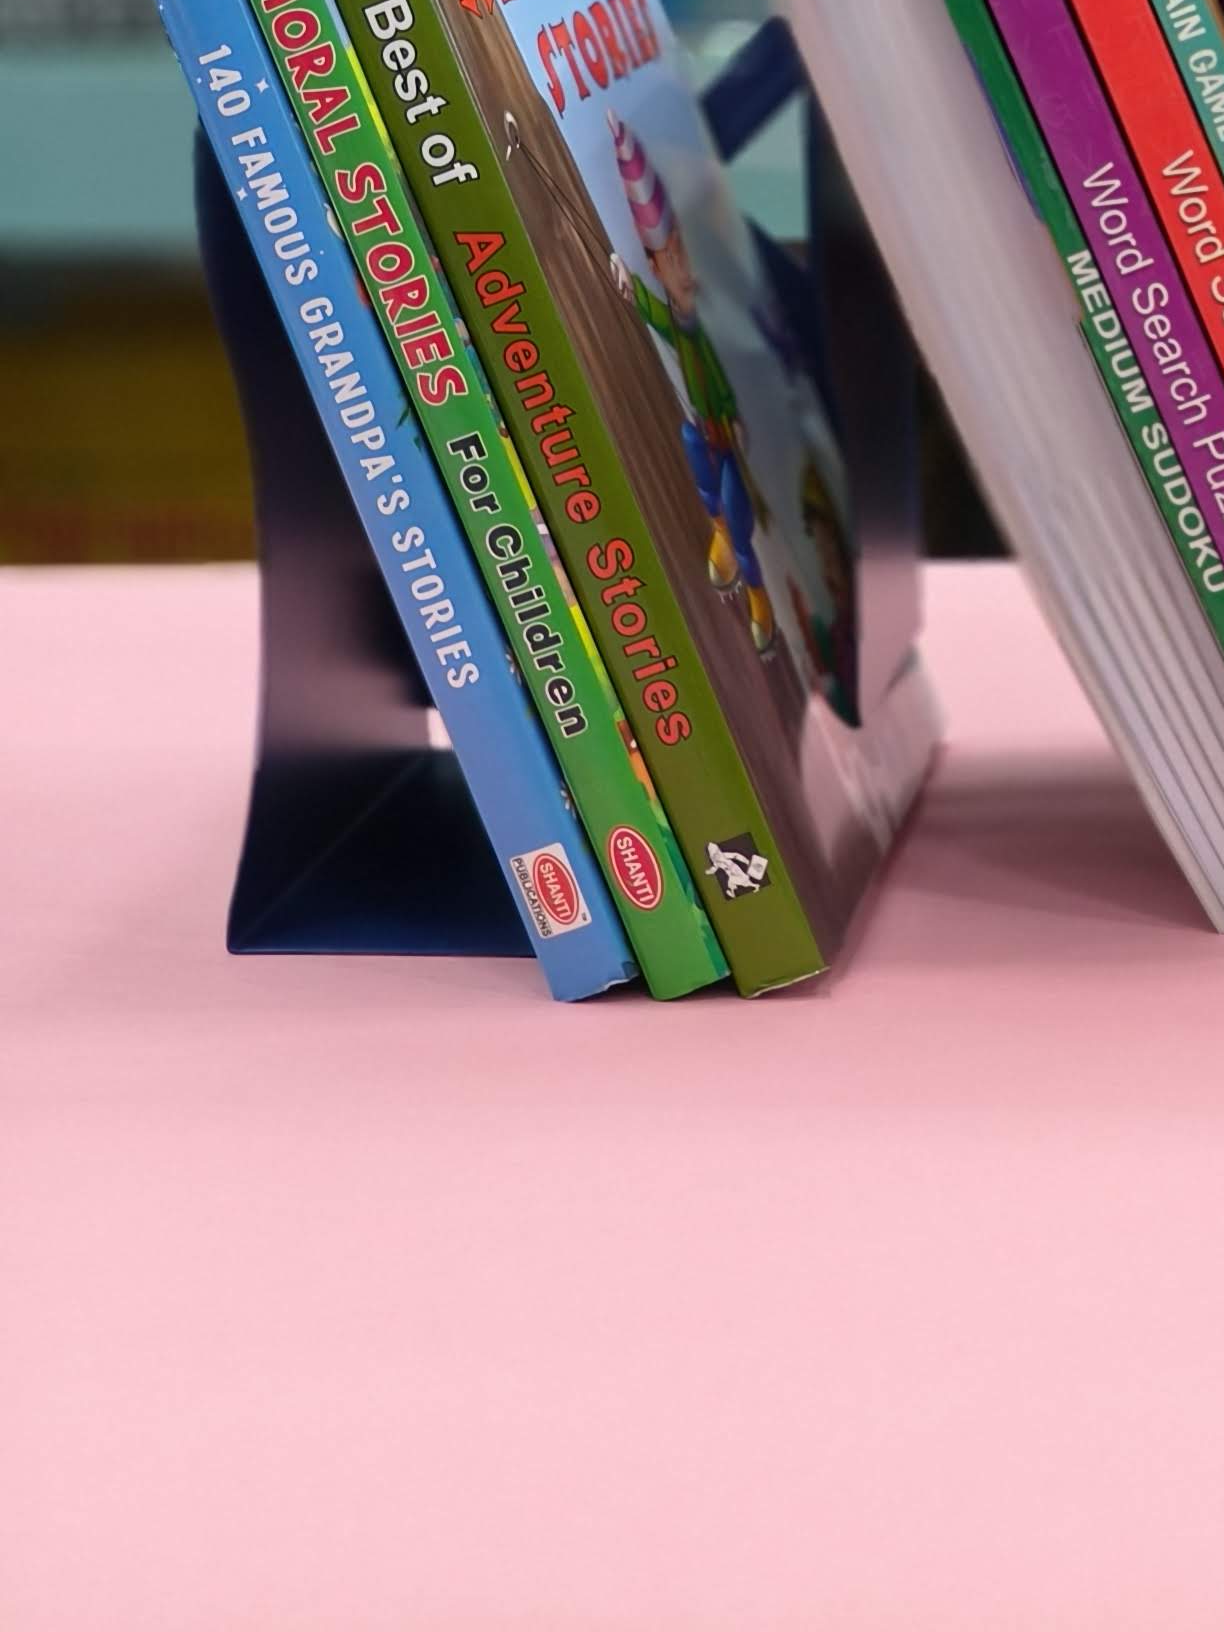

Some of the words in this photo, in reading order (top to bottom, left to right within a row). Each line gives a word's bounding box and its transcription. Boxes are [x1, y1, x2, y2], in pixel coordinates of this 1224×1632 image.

[199, 44, 251, 118] 140
[232, 127, 318, 286] FAMOUS
[300, 296, 410, 516] GRANDPA'S
[392, 526, 479, 689] STORIES
[1067, 248, 1154, 413] MEDIUM
[1083, 162, 1153, 275] Word
[1132, 283, 1212, 427] Search
[336, 163, 467, 405] STORIES
[446, 431, 500, 515] For
[486, 523, 588, 738] Children
[420, 132, 479, 186] of
[455, 231, 600, 525] Adventure
[586, 537, 692, 746] Stories
[512, 858, 552, 936] PUBLICATIONS
[540, 862, 571, 917] SHANTI
[617, 837, 654, 902] SHANTI
